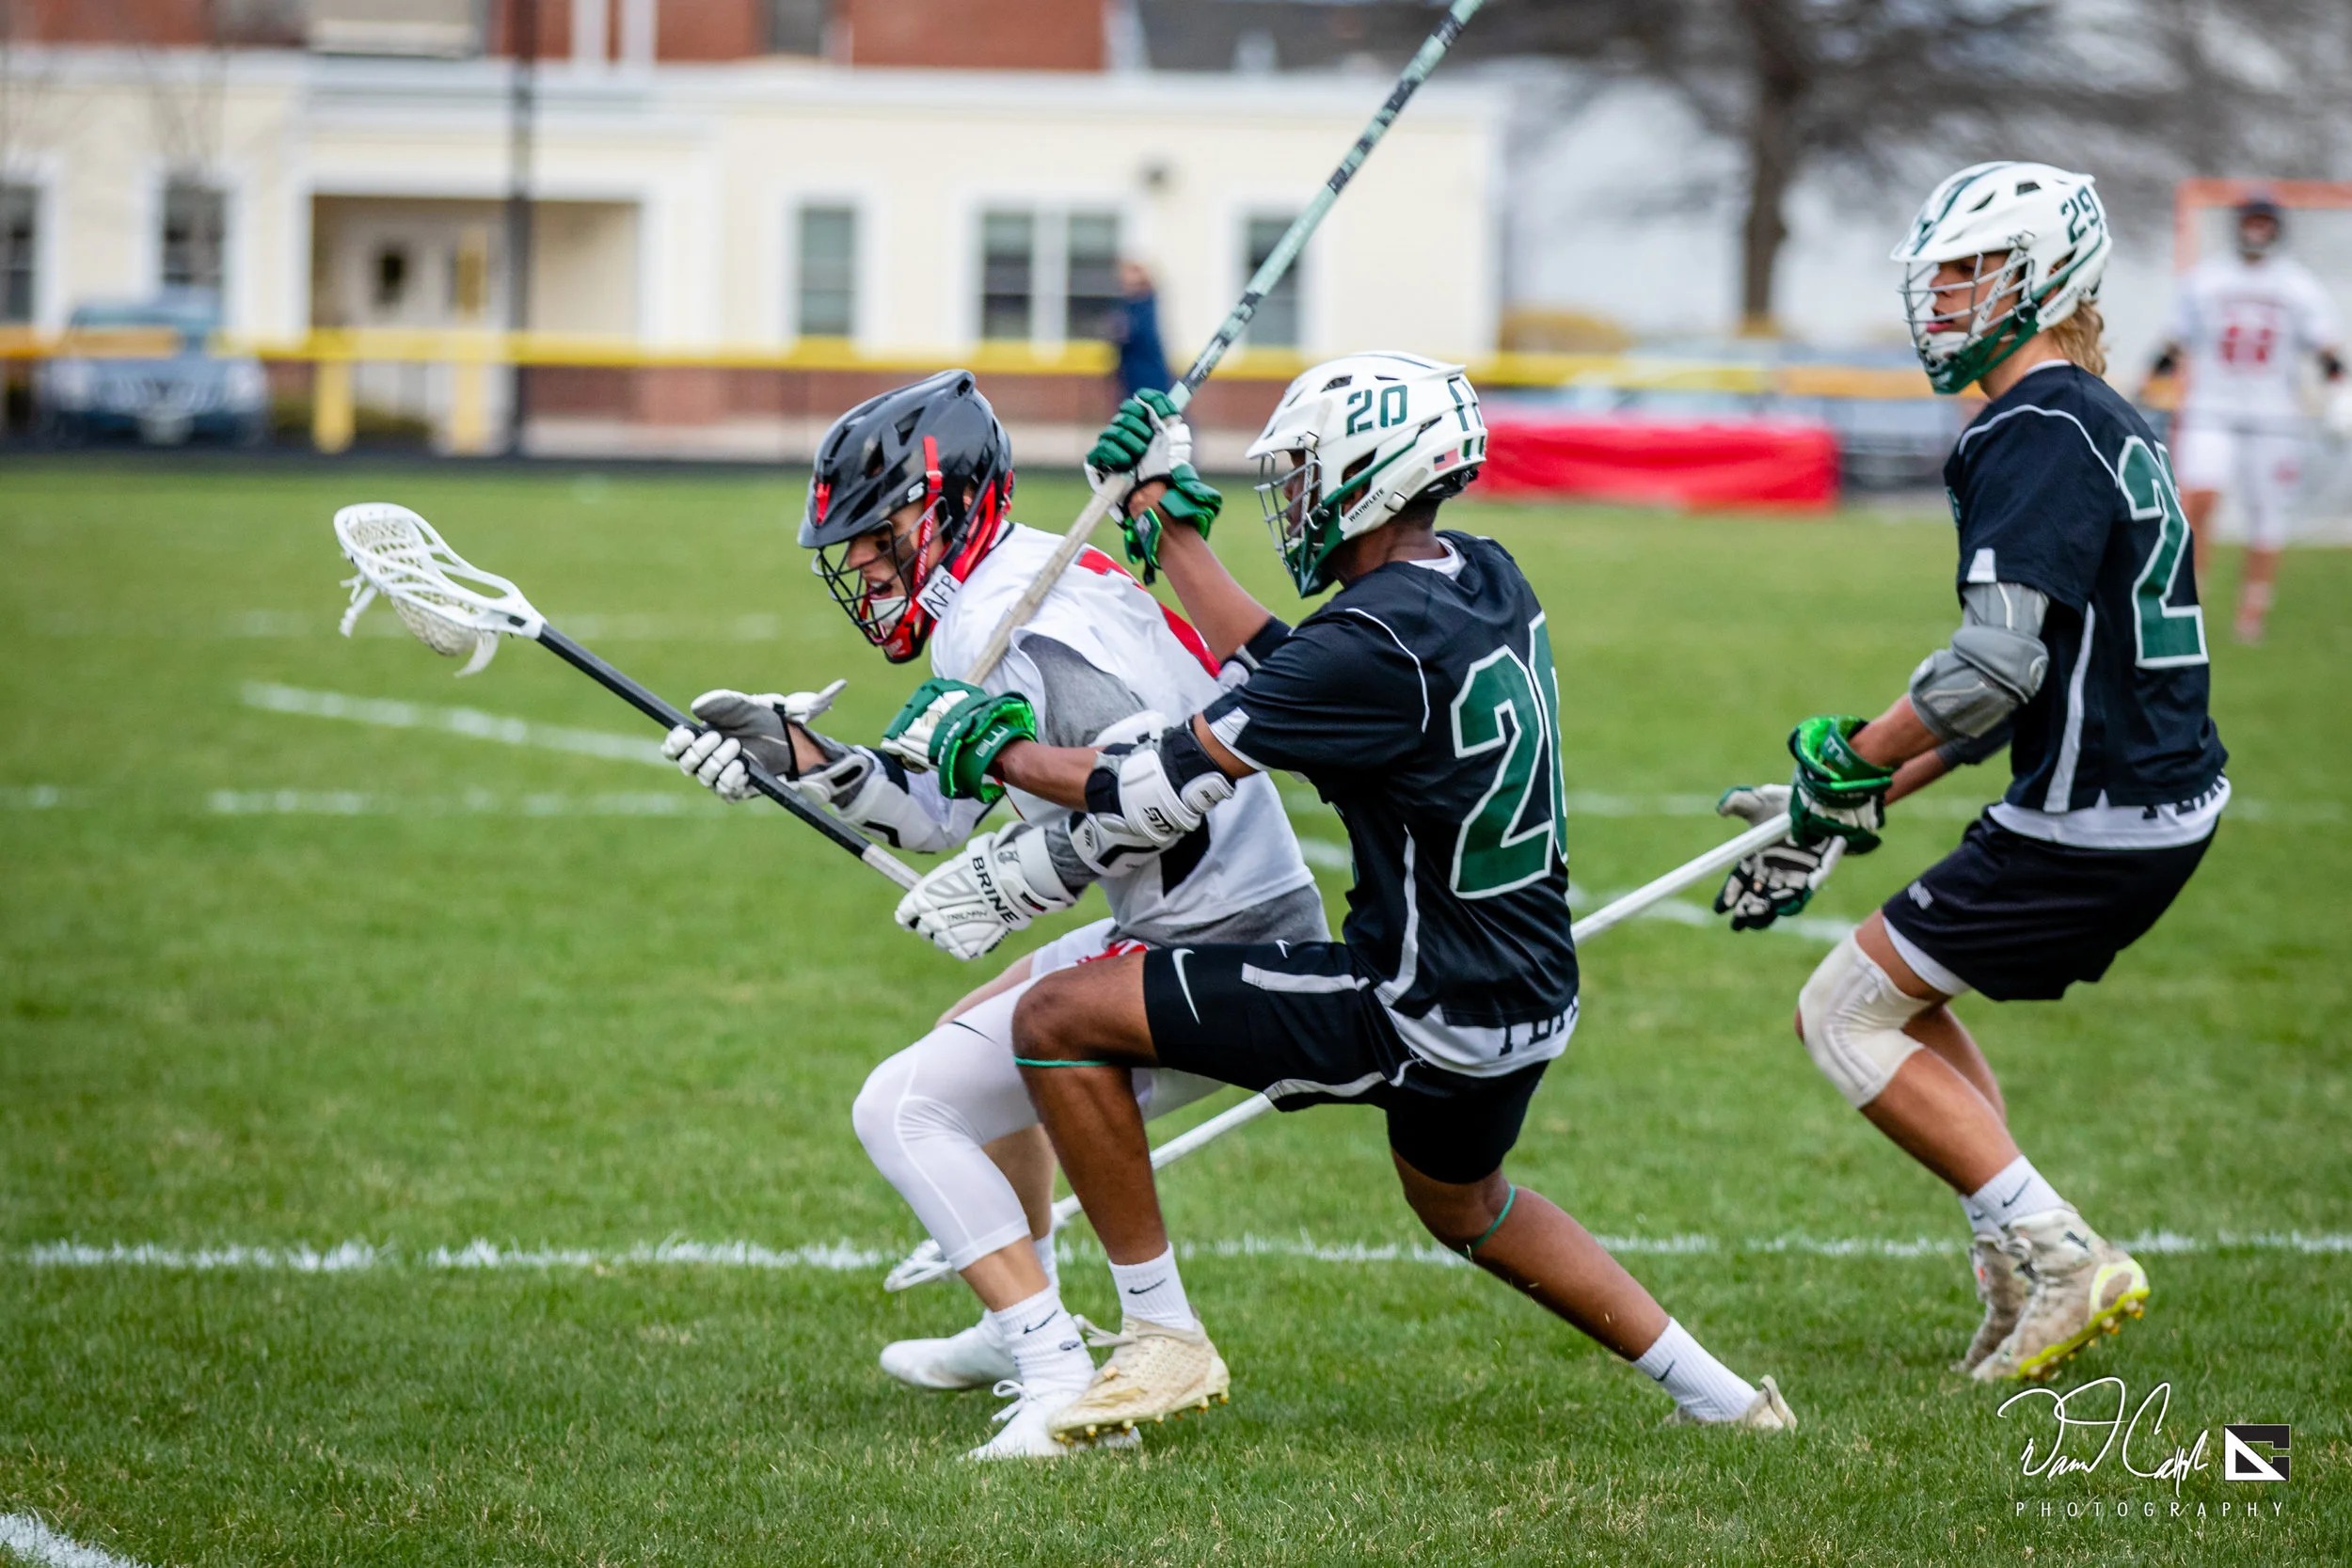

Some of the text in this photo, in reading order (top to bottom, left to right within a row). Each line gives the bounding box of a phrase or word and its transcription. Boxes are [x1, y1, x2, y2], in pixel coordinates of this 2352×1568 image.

[2060, 185, 2099, 245] 29
[1346, 385, 1407, 437] 20
[2117, 435, 2210, 669] 2
[972, 856, 1020, 924] BRINE
